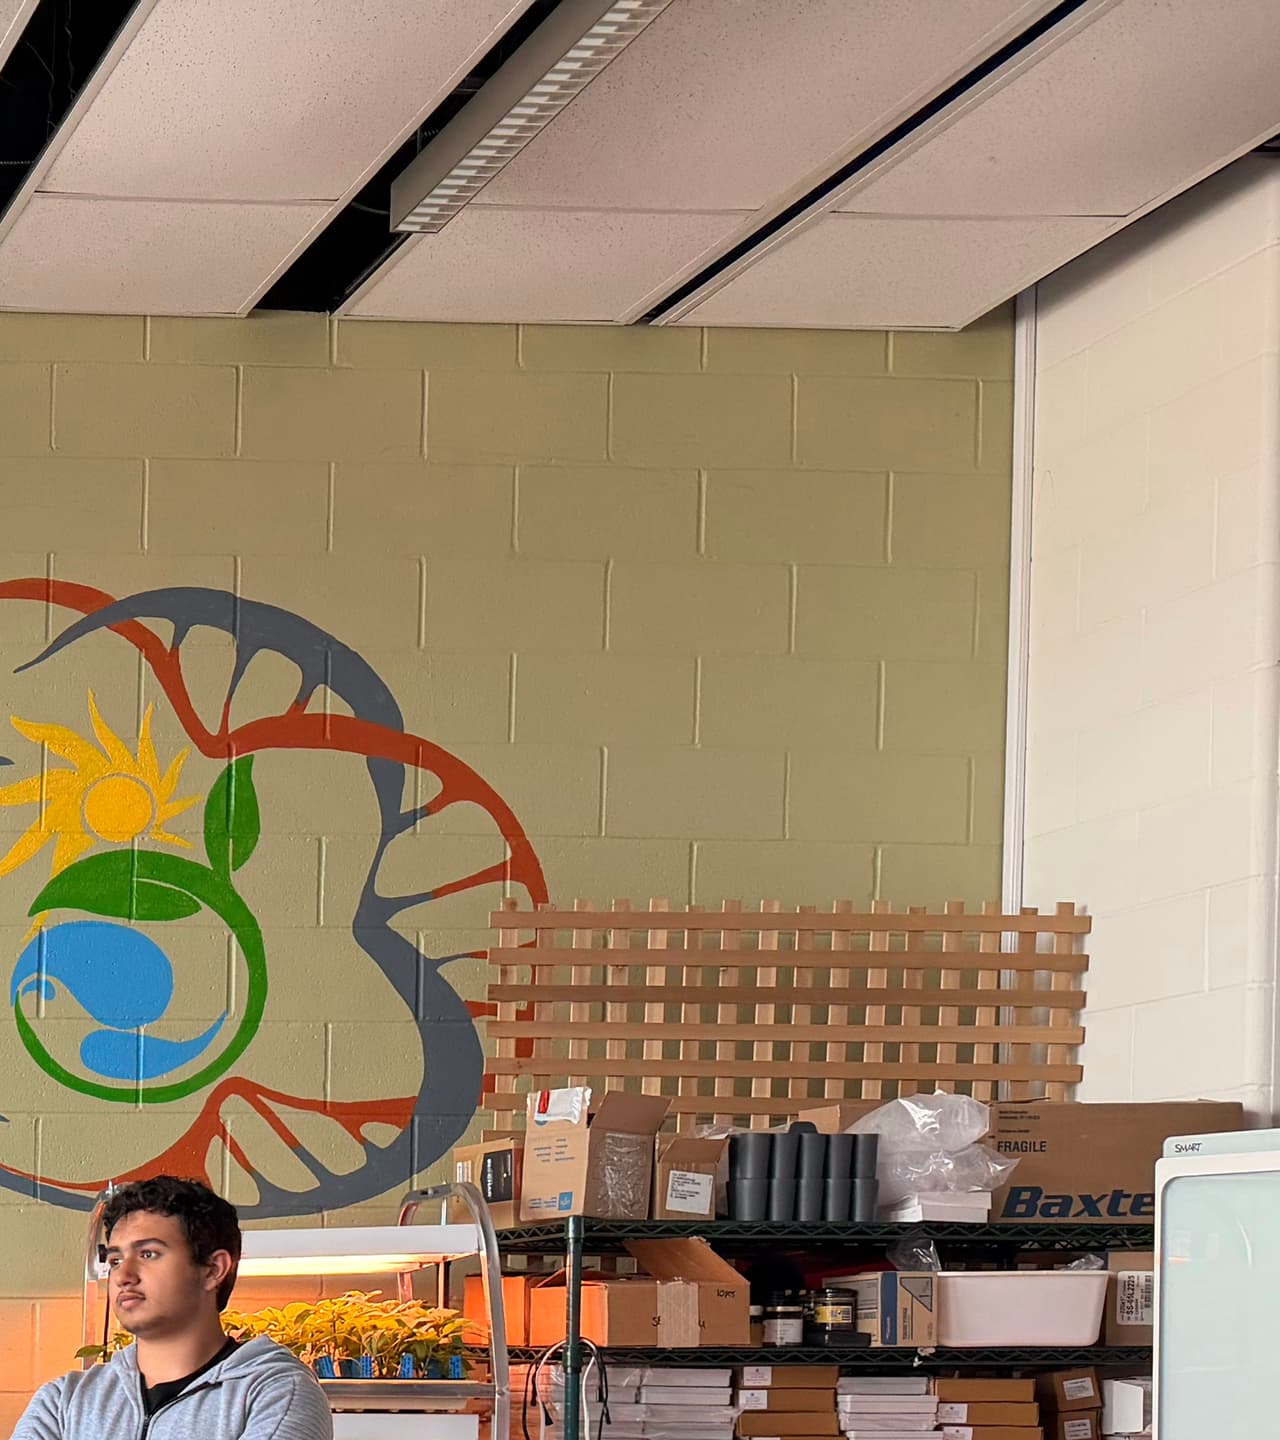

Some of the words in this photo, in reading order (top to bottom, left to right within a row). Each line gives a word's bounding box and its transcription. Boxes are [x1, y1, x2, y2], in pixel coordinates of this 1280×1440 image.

[997, 1140, 1047, 1153] FRAGILE
[1174, 1142, 1203, 1153] SMART
[1000, 1186, 1155, 1218] Baxte
